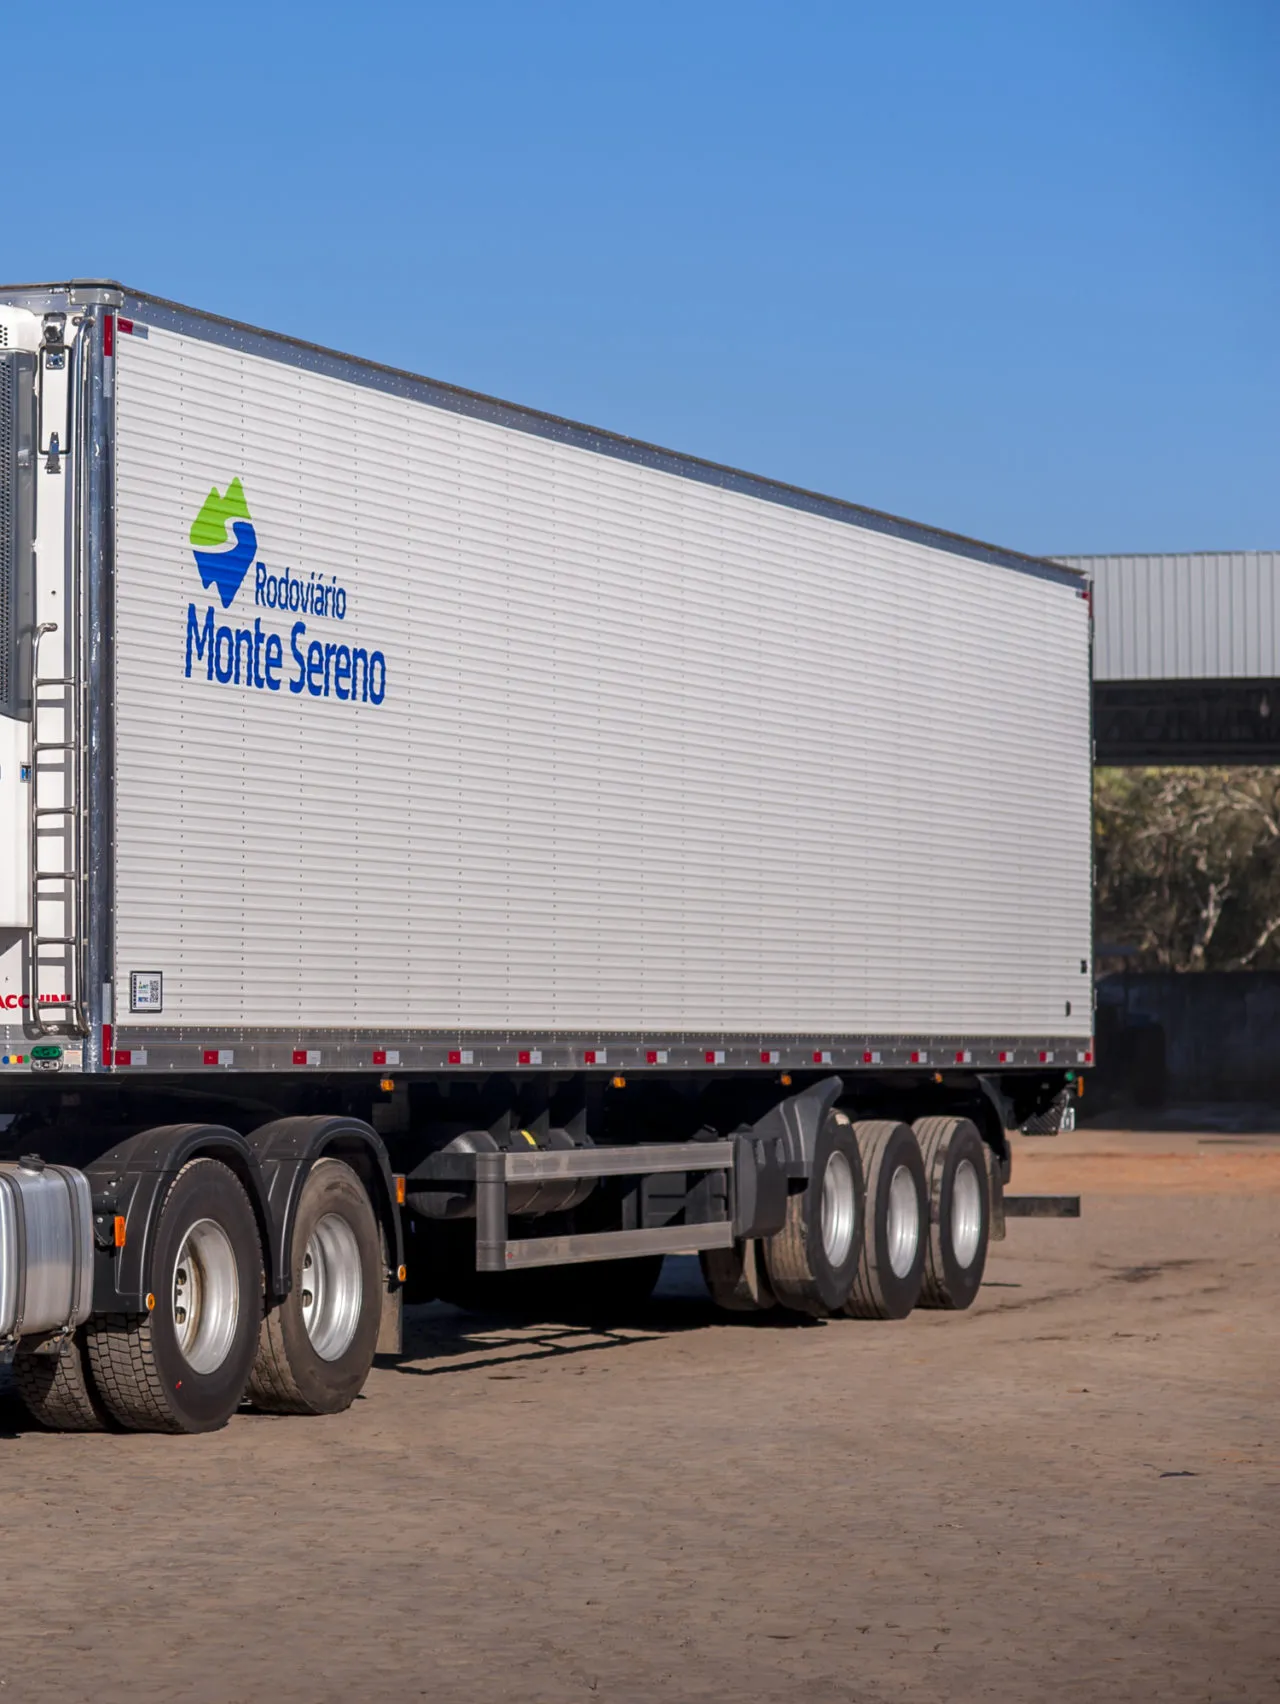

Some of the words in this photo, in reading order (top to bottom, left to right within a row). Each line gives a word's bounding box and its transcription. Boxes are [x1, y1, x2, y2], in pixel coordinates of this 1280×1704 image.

[255, 561, 347, 620] Rodoviário
[184, 602, 284, 691] Monte
[289, 621, 387, 706] Sereno
